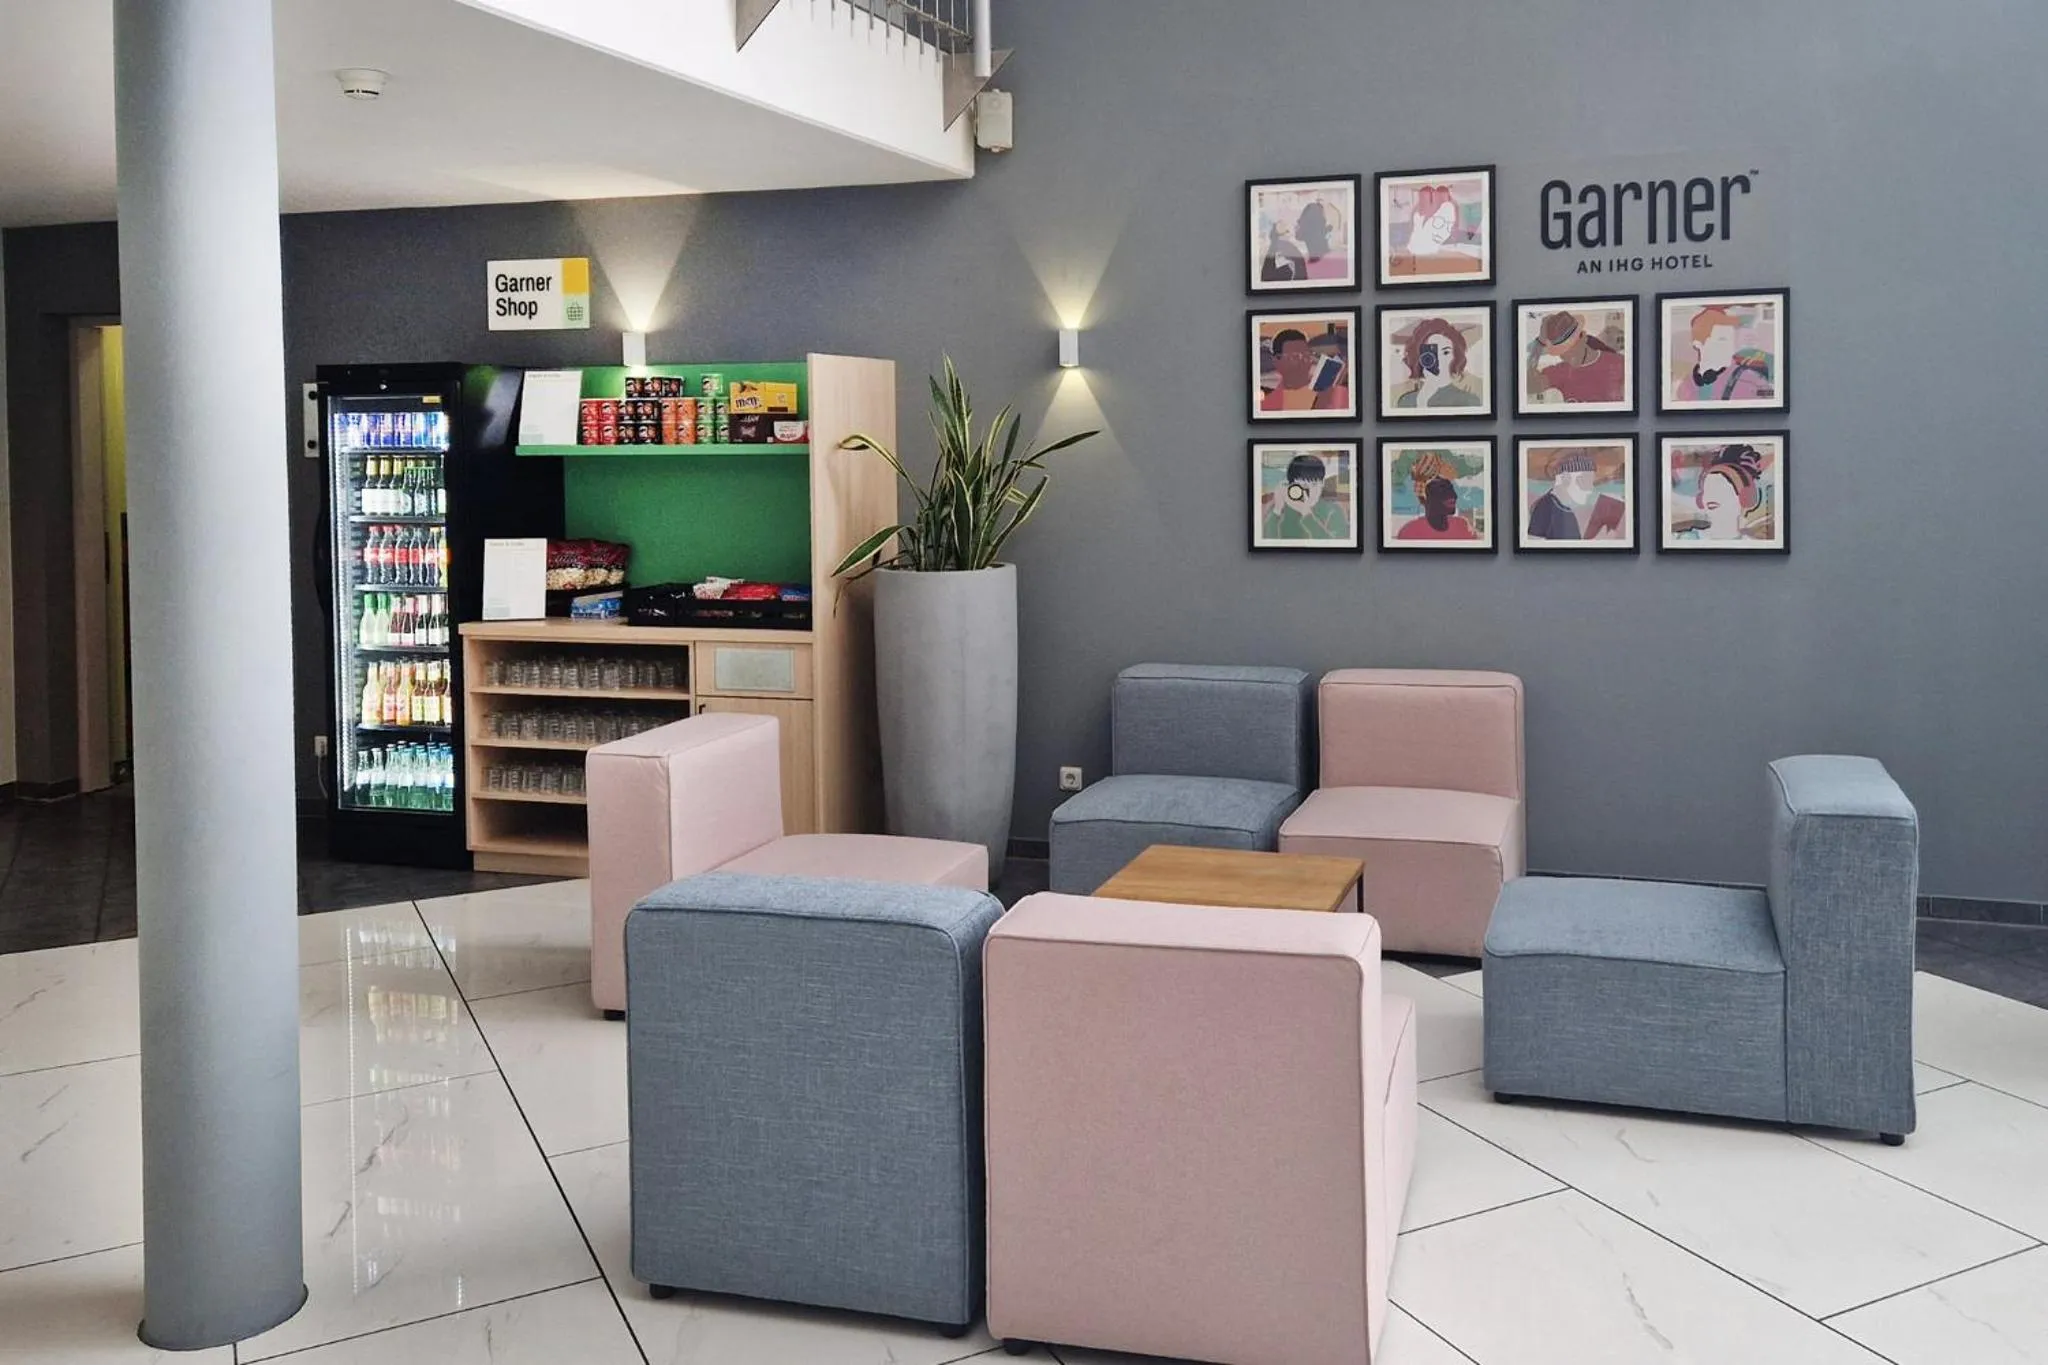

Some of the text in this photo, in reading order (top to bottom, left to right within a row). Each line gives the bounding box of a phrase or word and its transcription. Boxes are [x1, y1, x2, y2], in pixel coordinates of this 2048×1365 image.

[1576, 254, 1713, 274] AN IHG HOTEL
[495, 273, 553, 293] Garner
[495, 296, 538, 320] Shop
